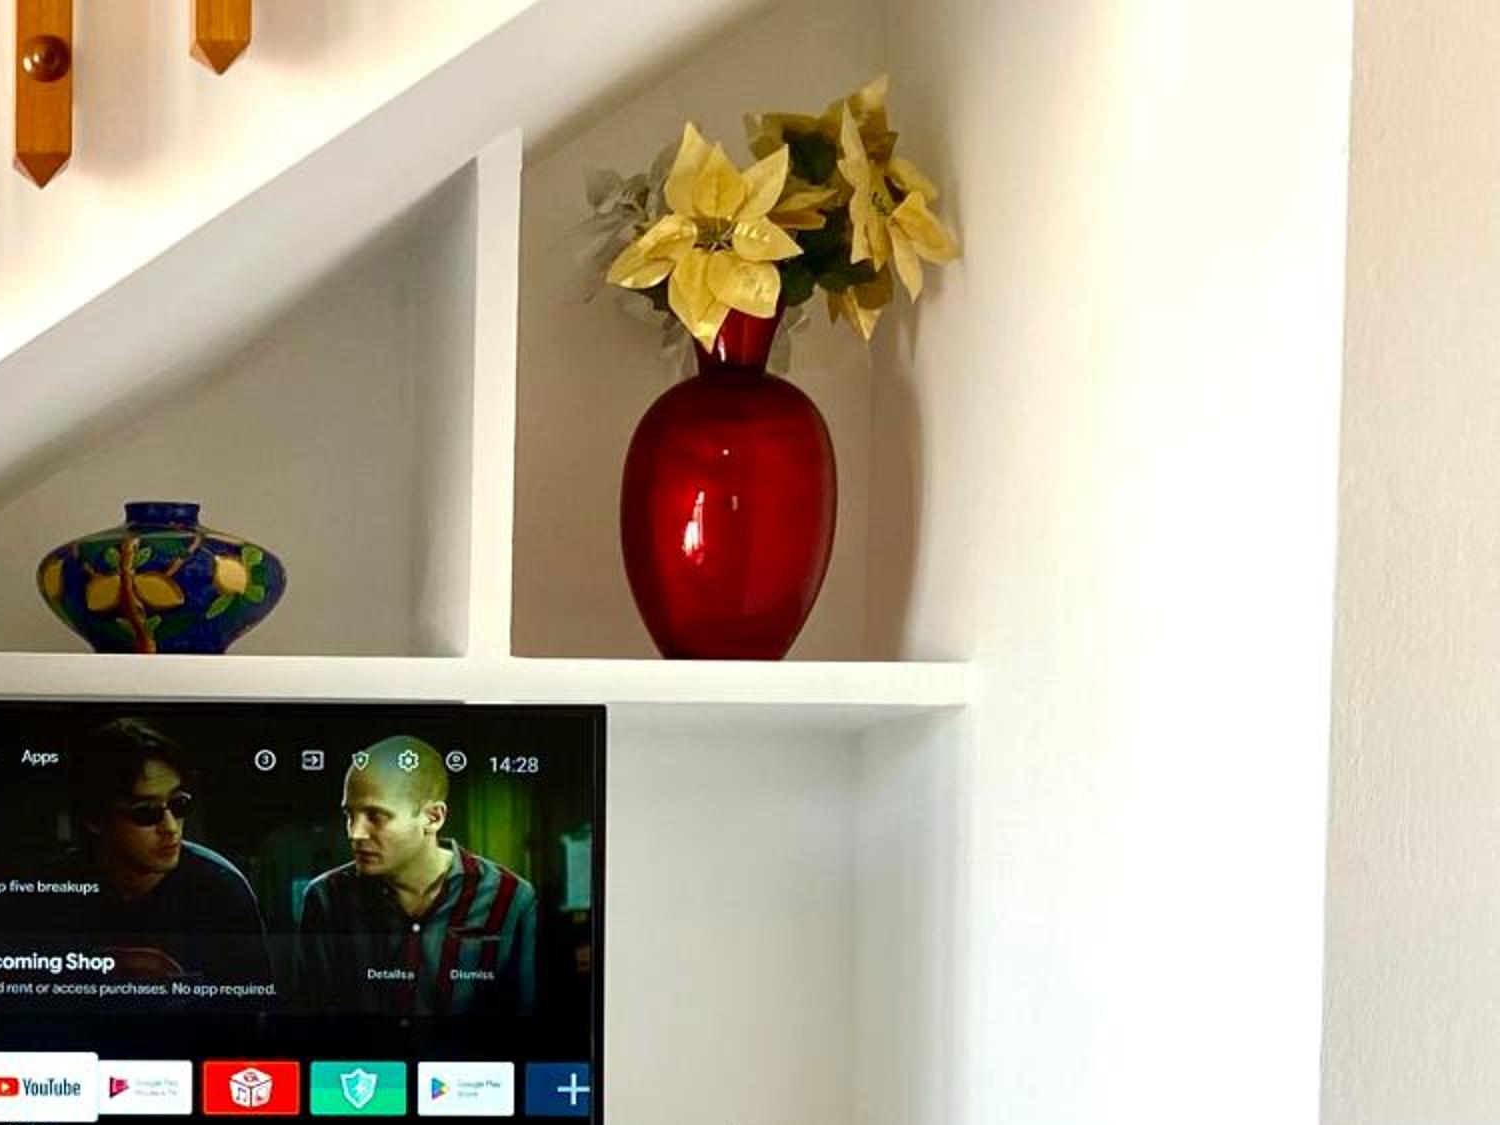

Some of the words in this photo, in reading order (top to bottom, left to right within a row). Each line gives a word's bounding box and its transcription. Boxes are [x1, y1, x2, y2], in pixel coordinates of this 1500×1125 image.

[21, 749, 59, 766] Apps
[489, 756, 539, 774] 14:28
[9, 880, 35, 893] five
[37, 880, 100, 896] breakups
[65, 953, 115, 974] Shop
[6, 983, 33, 994] rent
[35, 985, 49, 994] or
[52, 984, 97, 995] access
[100, 983, 169, 998] purchases.
[172, 983, 191, 995] No
[193, 986, 218, 998] app
[220, 984, 276, 998] required.
[22, 1077, 82, 1097] YouTube
